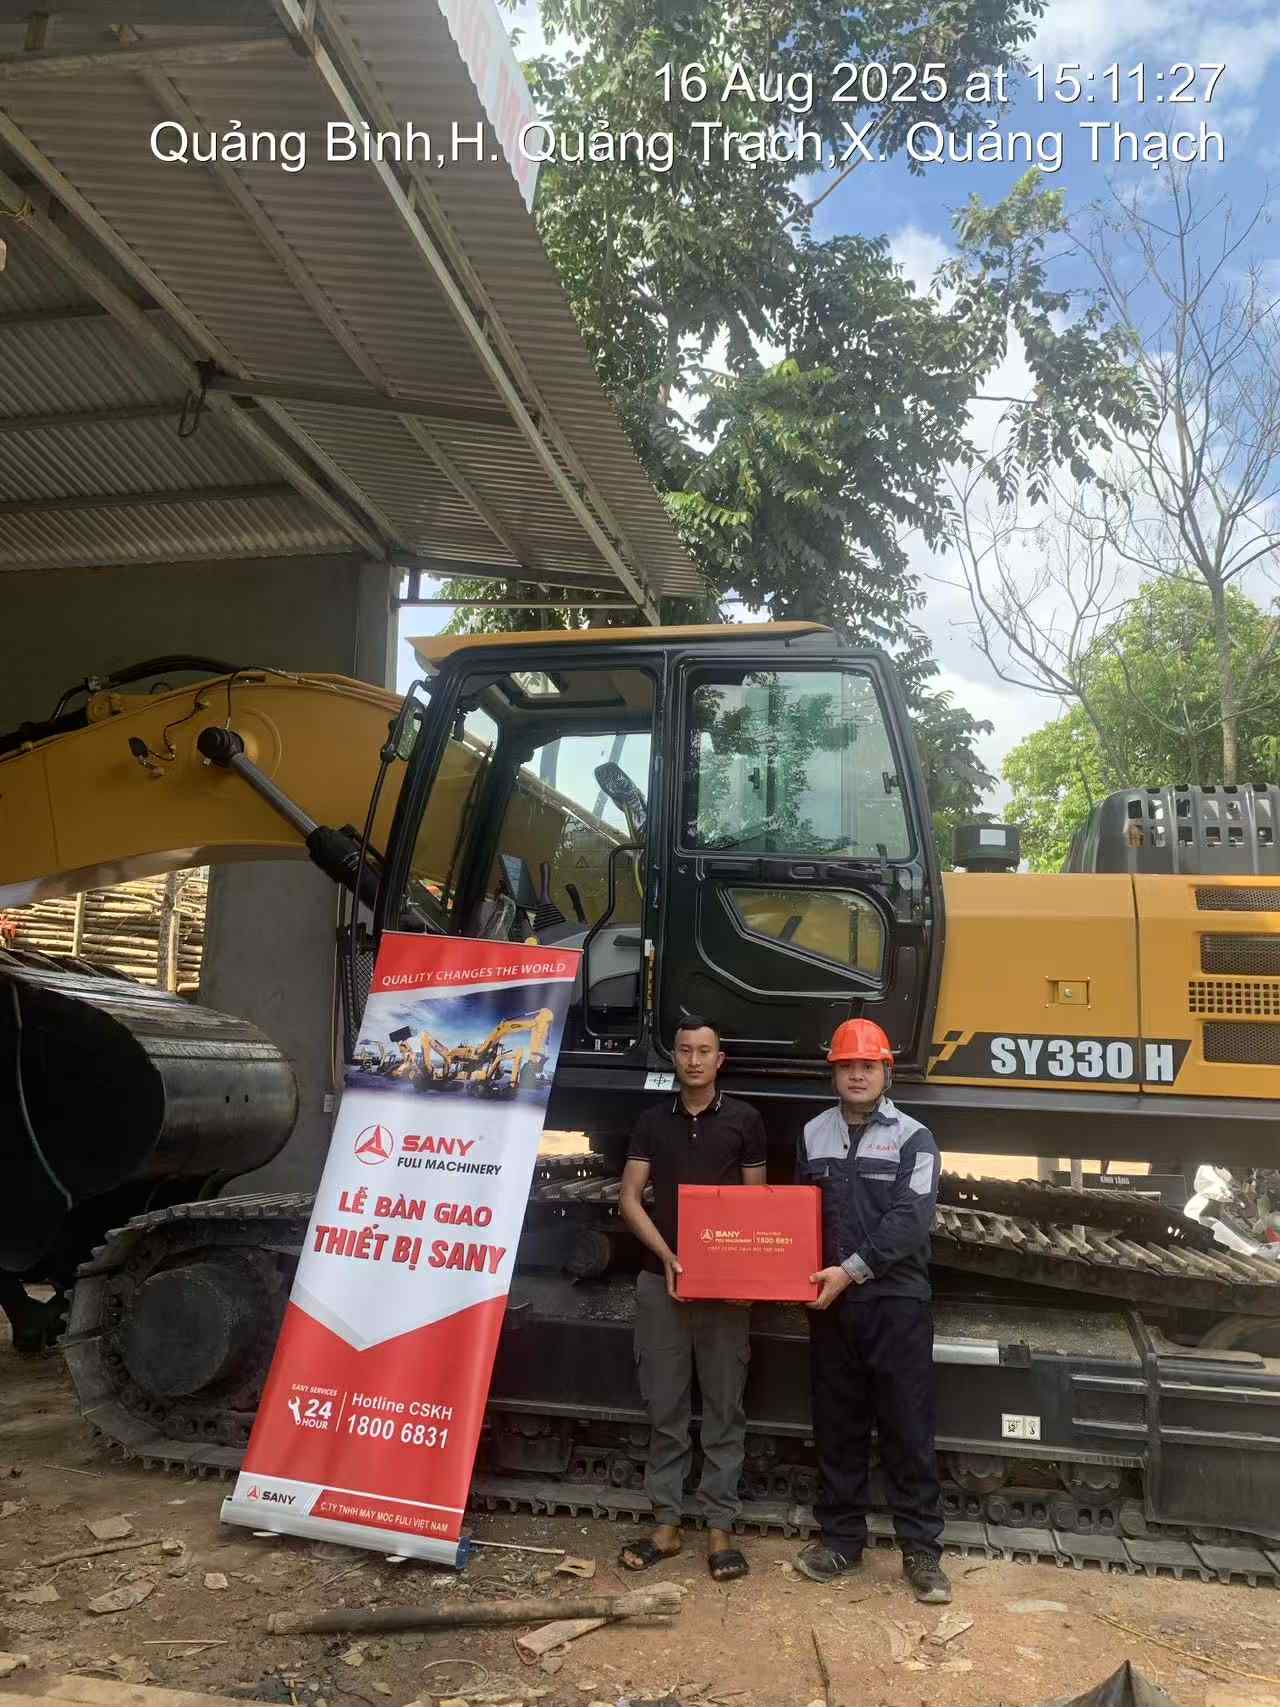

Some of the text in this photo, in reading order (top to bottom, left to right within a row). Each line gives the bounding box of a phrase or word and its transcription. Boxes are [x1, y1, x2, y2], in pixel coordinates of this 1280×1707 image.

[382, 961, 567, 987] QUALITY CHANGES THE WORLD
[989, 1037, 1134, 1079] SY330
[401, 1135, 476, 1157] SANY
[397, 1156, 503, 1177] FULI MACHINERY
[338, 1186, 494, 1229] LỄ BÀN GIAO
[313, 1223, 507, 1275] THIẾT BỊ SANY
[303, 1398, 334, 1420] 24
[351, 1392, 454, 1421] Hotline CSKH
[300, 1417, 329, 1431] HOUR
[347, 1414, 449, 1449] 1800 6831
[261, 1490, 297, 1505] SANY
[394, 1514, 412, 1527] FULI
[430, 1520, 449, 1533] NAM
